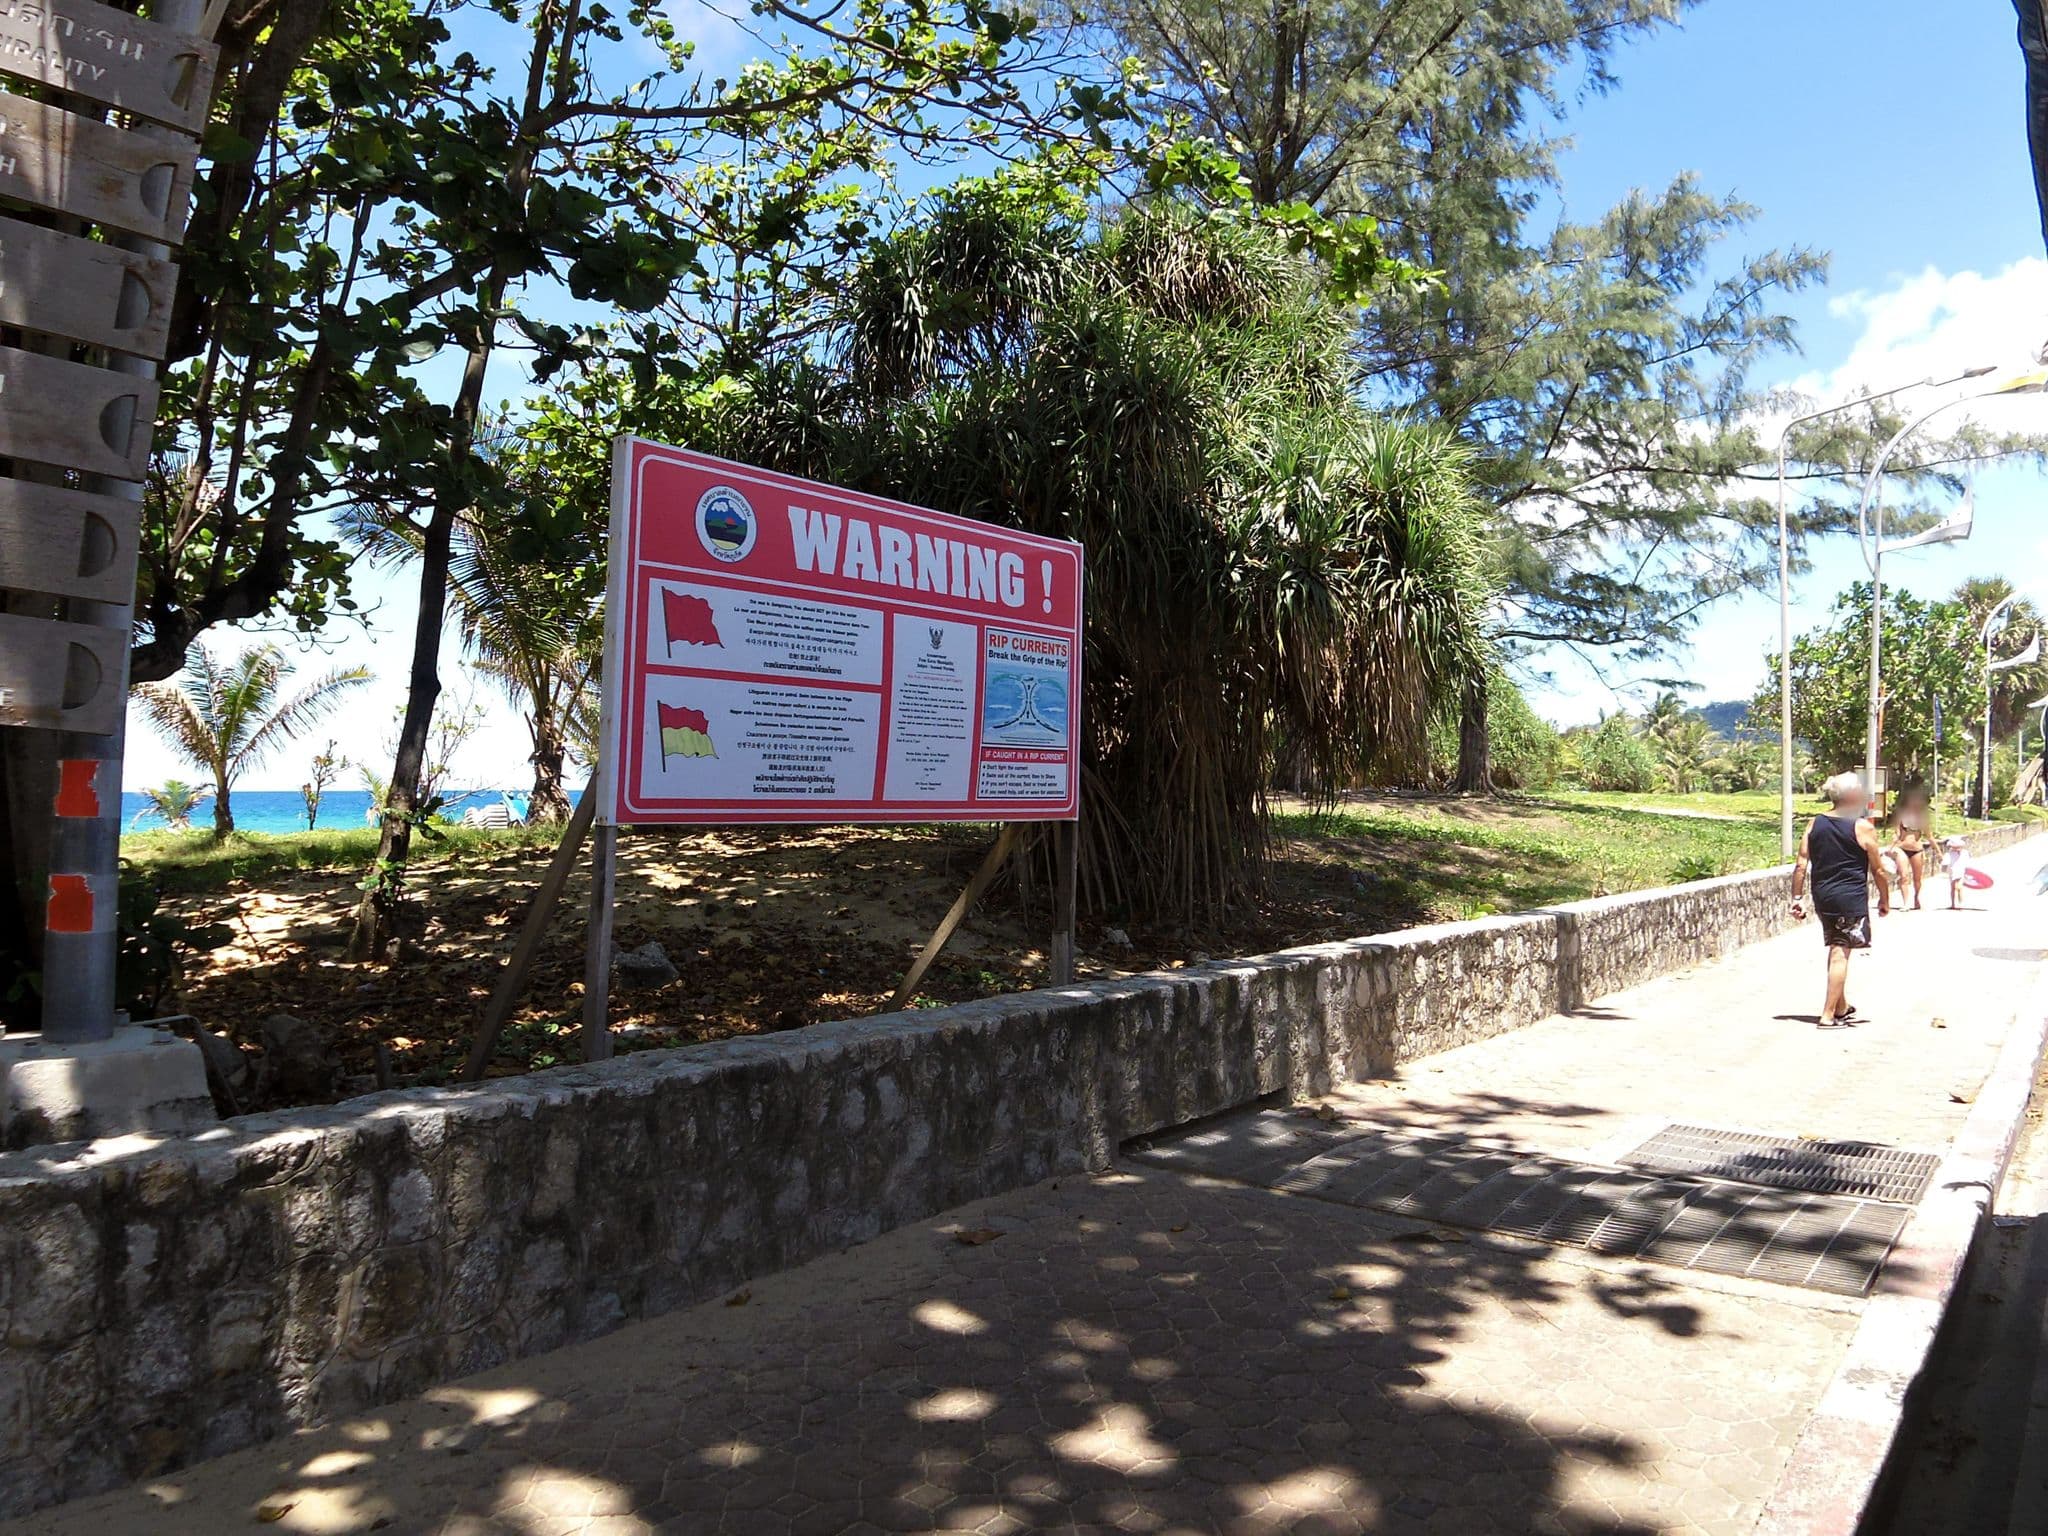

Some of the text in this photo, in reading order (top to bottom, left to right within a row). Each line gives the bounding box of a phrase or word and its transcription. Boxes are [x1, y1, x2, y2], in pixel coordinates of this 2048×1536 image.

[0, 33, 107, 81] IPALITY
[787, 505, 1053, 615] WARNING !
[989, 634, 1067, 656] RIP CURRENTS
[988, 649, 1009, 660] Break
[1010, 653, 1021, 661] the
[1022, 654, 1036, 665] Grip
[1037, 656, 1044, 665] of
[1044, 657, 1055, 666] the
[992, 751, 1016, 759] CAUGHT
[1029, 752, 1039, 760] RIP
[1039, 753, 1065, 761] CURRENT
